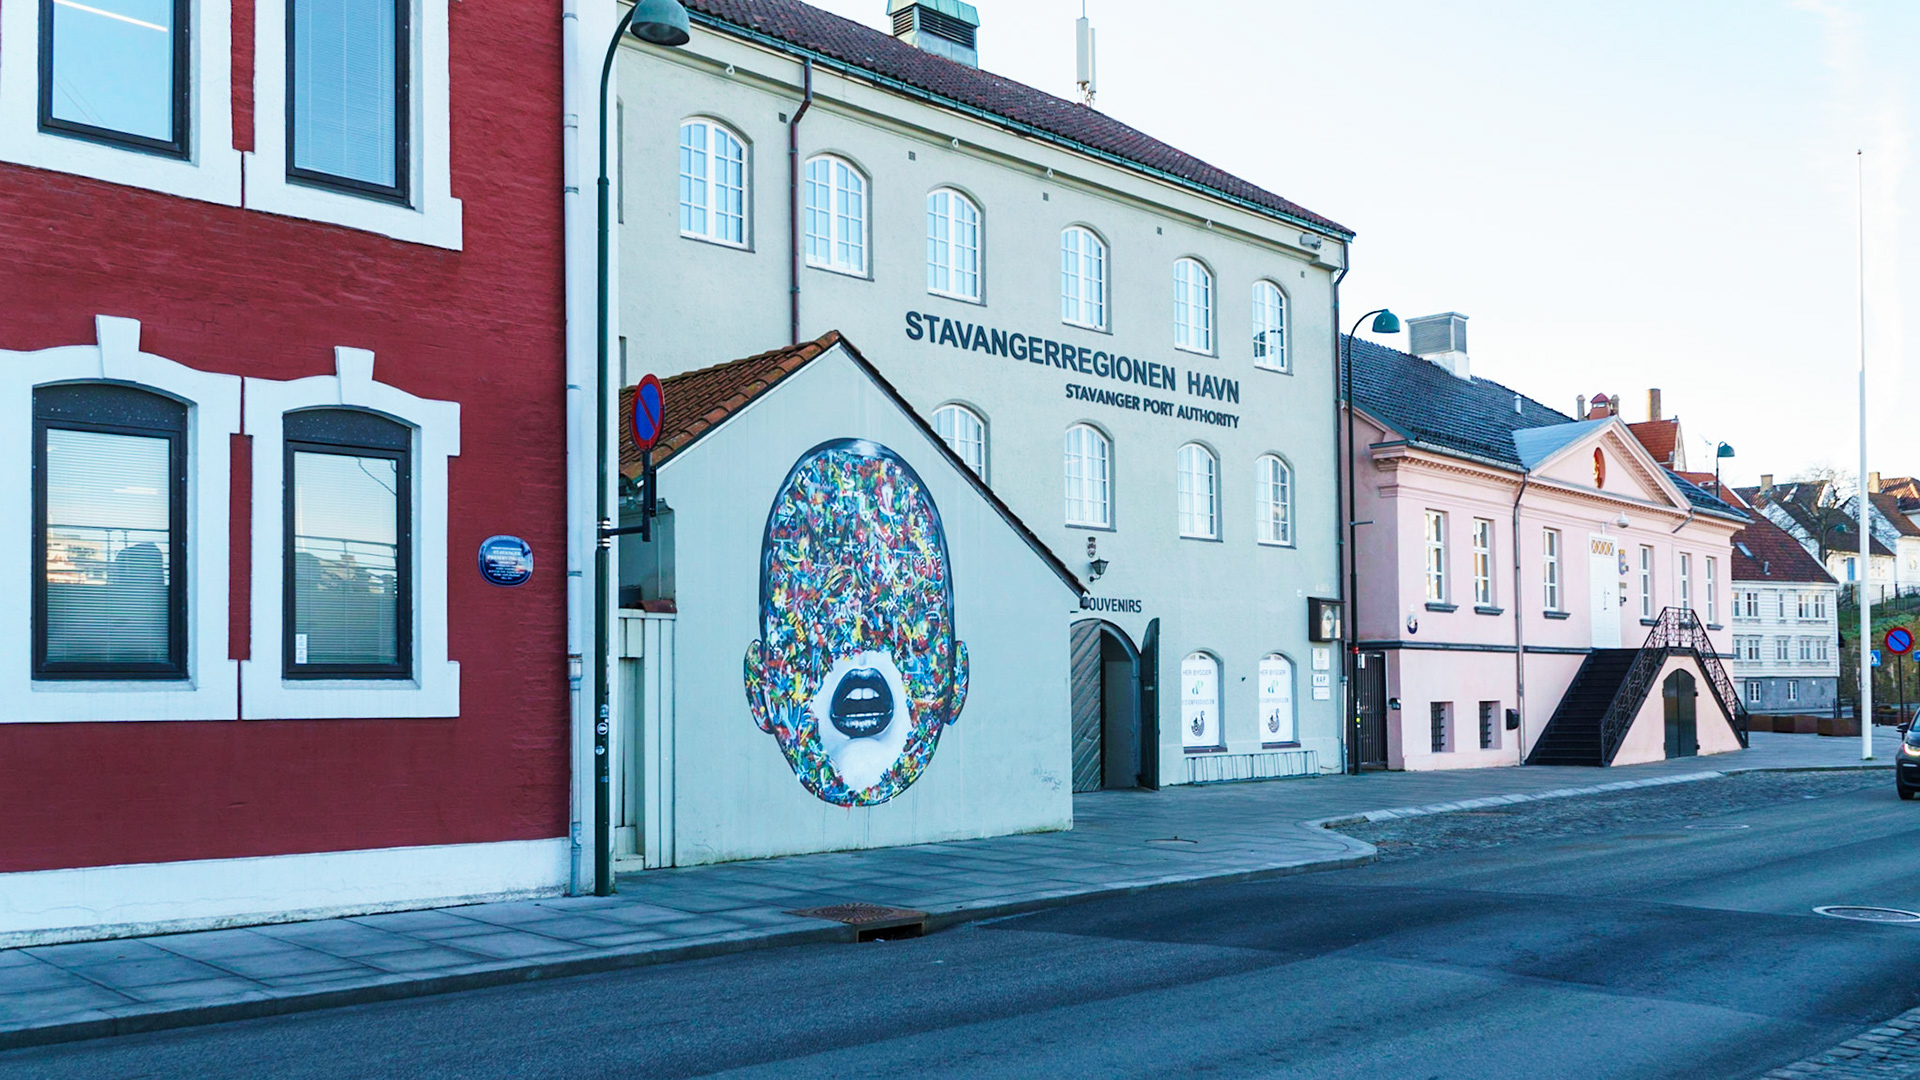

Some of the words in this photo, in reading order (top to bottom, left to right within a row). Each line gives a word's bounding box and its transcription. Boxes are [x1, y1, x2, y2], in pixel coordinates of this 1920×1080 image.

[905, 311, 1176, 391] STAVANGERREGIONEN
[1187, 371, 1240, 404] HAVN
[1065, 383, 1140, 411] STAVANGER
[1143, 398, 1175, 416] PORT
[1176, 405, 1240, 429] AUTHORITY
